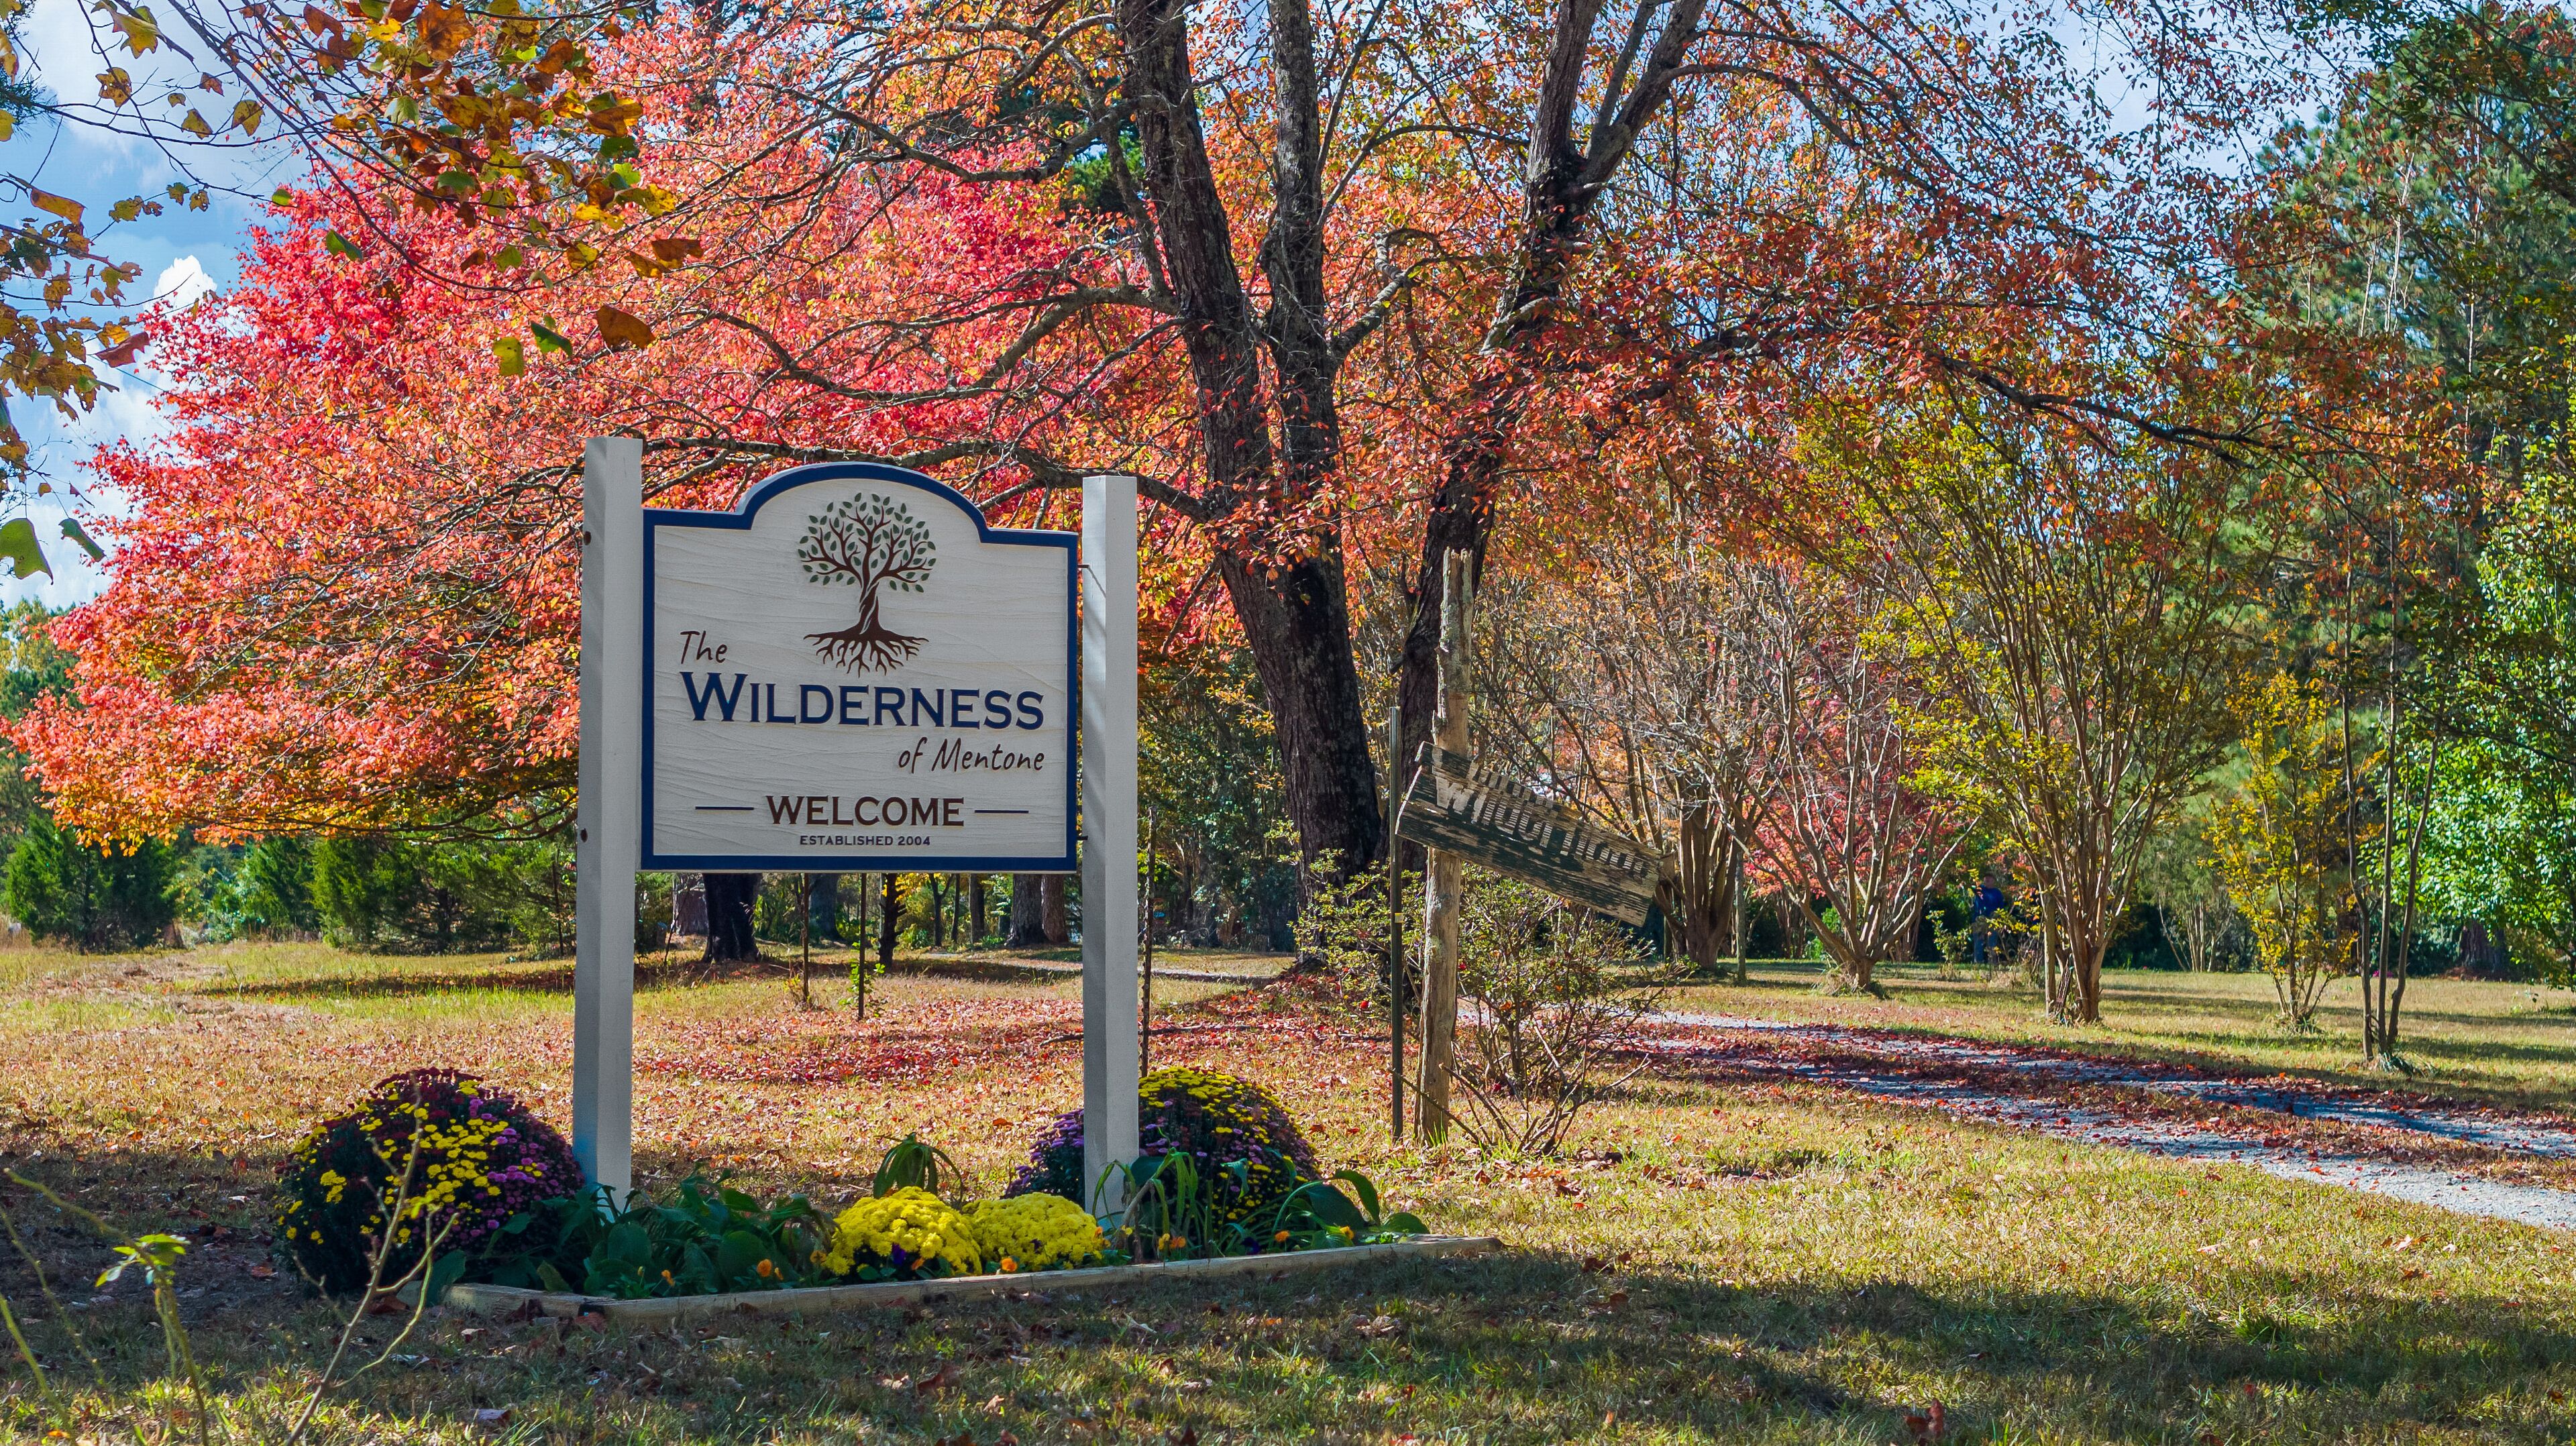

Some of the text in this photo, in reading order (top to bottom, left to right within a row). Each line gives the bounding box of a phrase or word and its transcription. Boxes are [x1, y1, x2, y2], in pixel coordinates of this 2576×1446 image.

[680, 630, 728, 664] The
[680, 671, 1044, 730] WILDERNESS
[898, 736, 1045, 773] of Mentone
[765, 795, 965, 826] WELCOME
[800, 835, 931, 846] ESTABLISHED 2004
